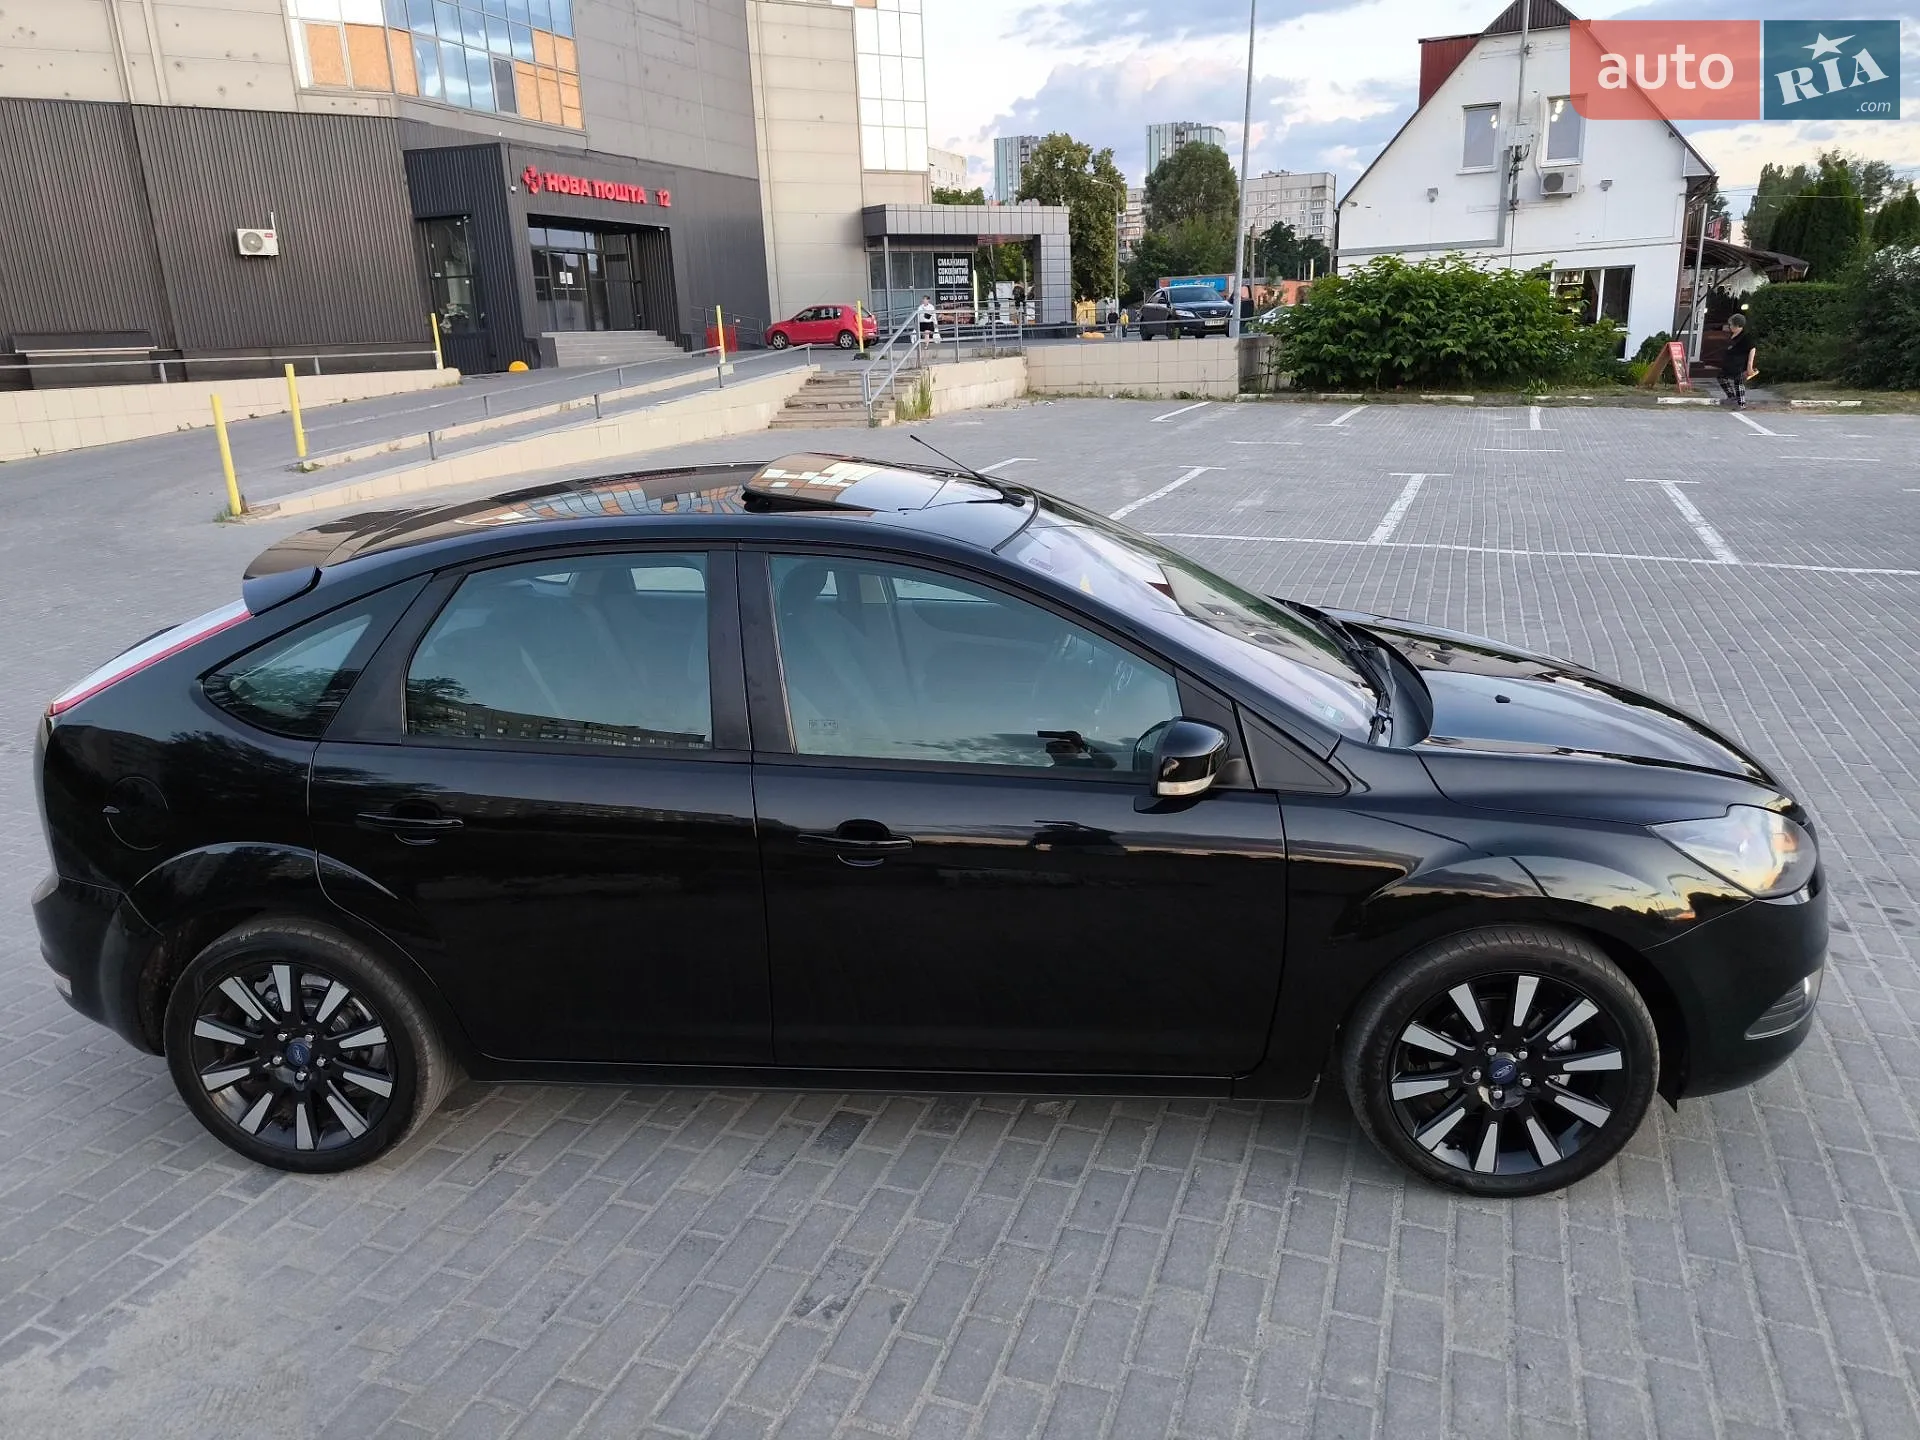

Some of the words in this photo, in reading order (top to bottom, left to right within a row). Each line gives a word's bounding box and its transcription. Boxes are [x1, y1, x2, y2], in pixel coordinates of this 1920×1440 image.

[544, 172, 593, 197] НОВА
[592, 180, 647, 204] ПОШТА
[656, 189, 672, 207] 12
